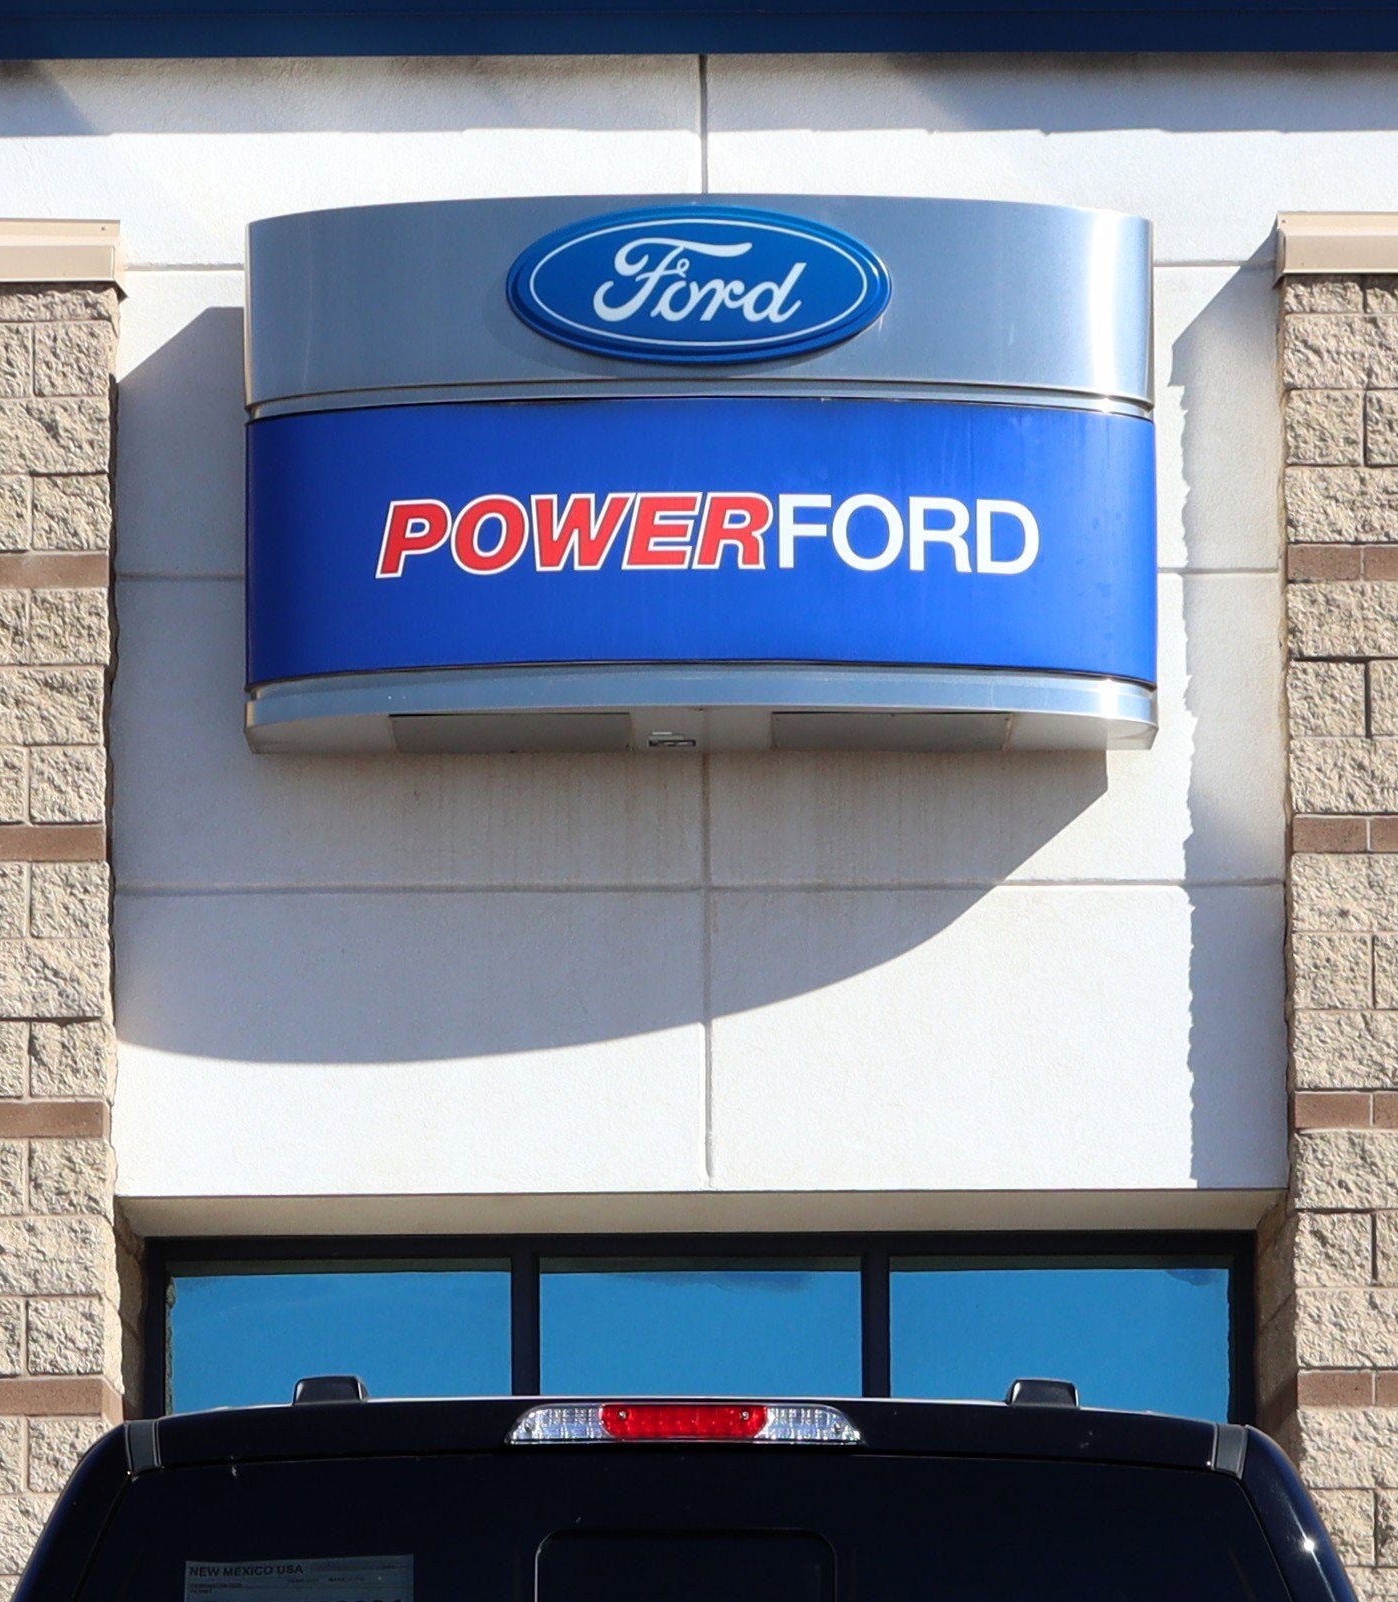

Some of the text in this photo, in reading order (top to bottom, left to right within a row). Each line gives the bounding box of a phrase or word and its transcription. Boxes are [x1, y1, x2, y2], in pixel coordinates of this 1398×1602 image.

[593, 237, 806, 324] Ford
[375, 491, 1040, 578] POWERFORD
[189, 1566, 219, 1578] NEW
[222, 1565, 273, 1577] MEXICO
[276, 1564, 303, 1575] USA
